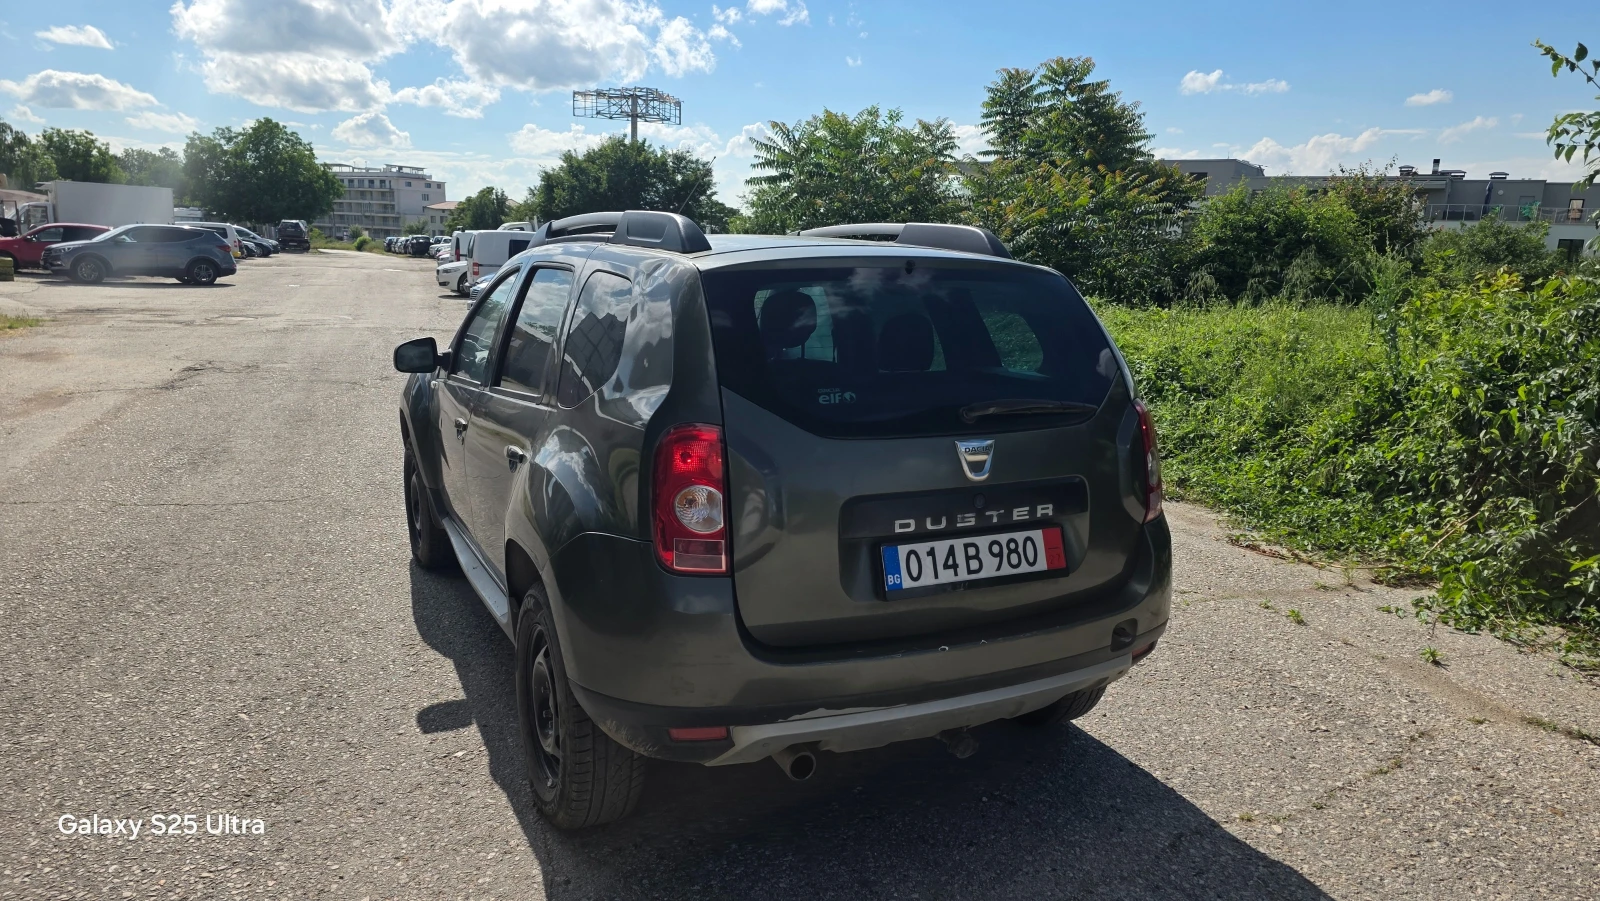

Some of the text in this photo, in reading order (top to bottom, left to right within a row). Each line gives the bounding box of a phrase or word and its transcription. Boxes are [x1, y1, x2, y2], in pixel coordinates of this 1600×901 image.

[818, 393, 842, 404] elf
[894, 504, 1053, 533] DUSTER
[887, 574, 901, 585] BG
